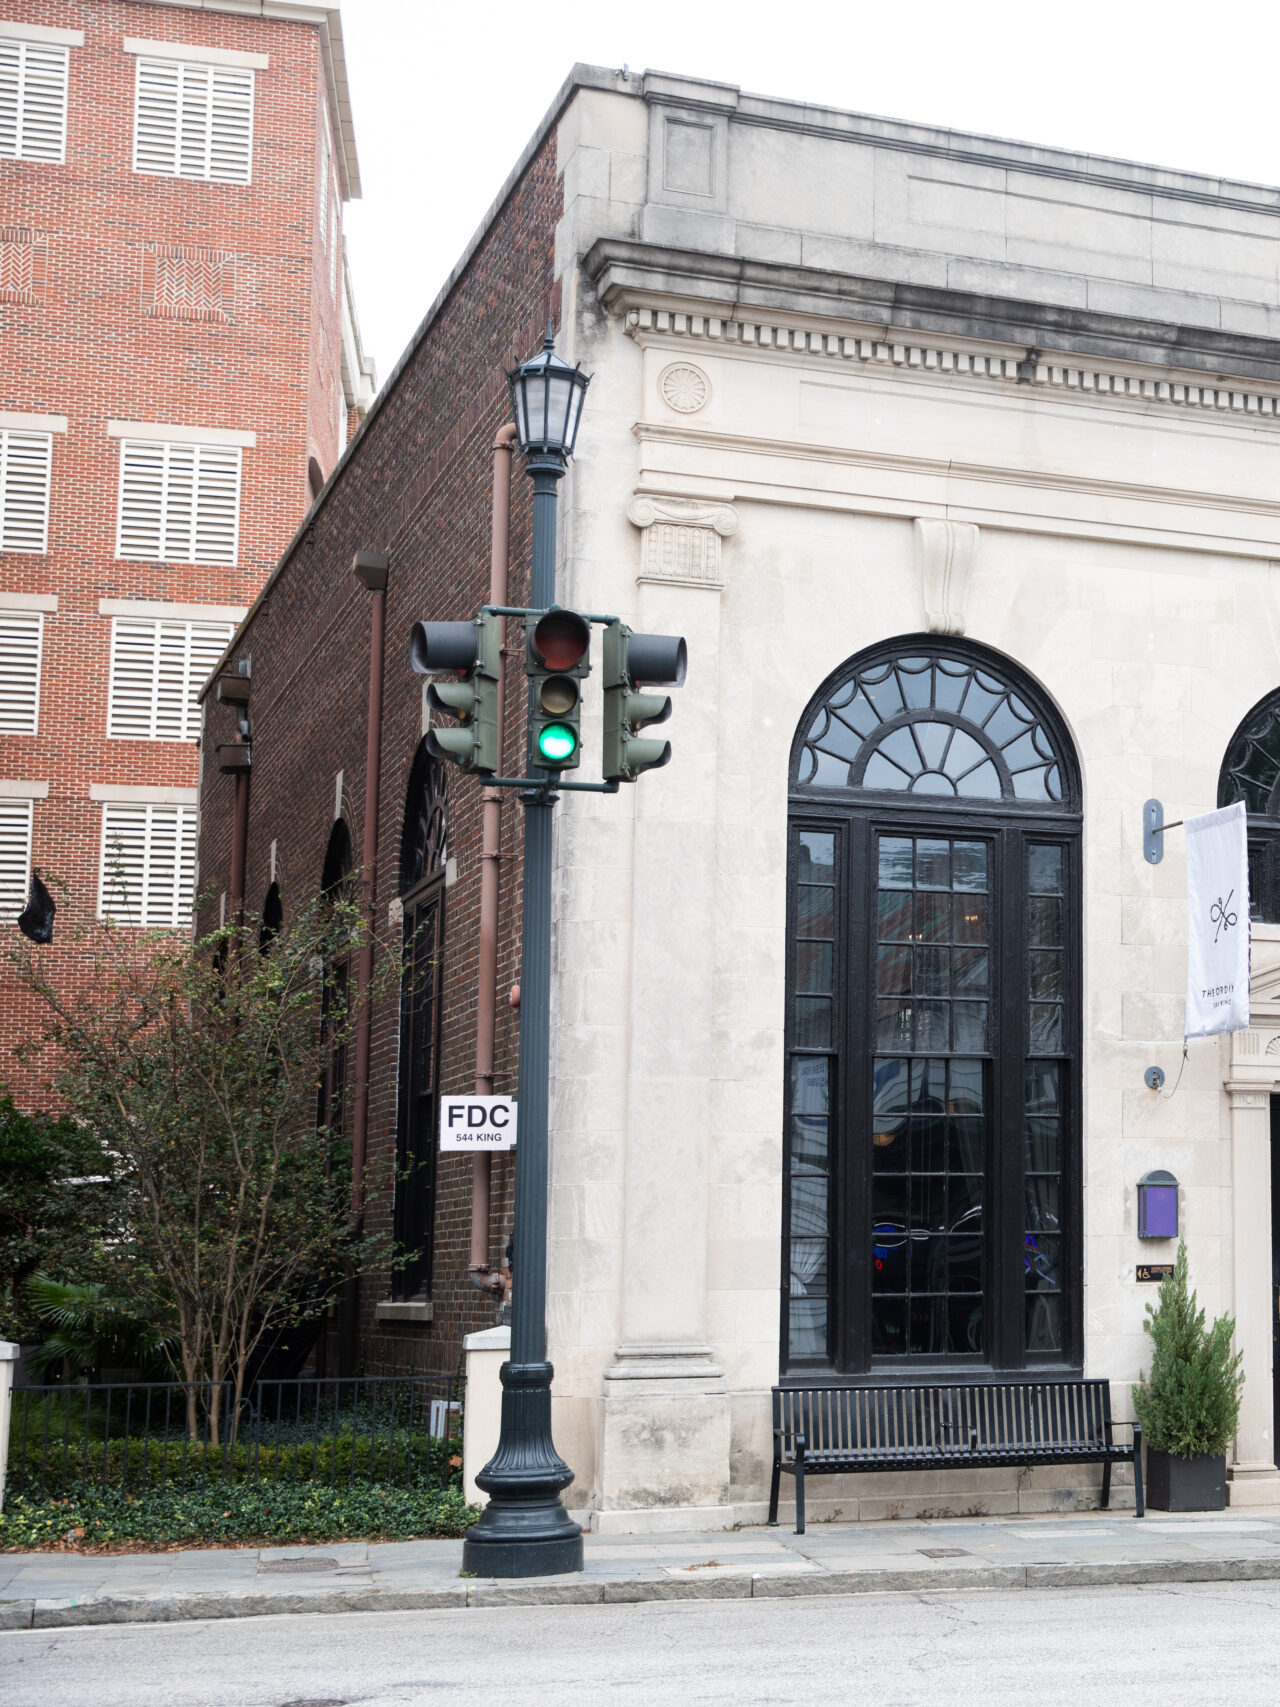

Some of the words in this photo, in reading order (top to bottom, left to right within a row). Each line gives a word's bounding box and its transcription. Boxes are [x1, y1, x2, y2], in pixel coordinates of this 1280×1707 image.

[448, 1104, 509, 1128] FDC
[456, 1133, 473, 1142] 544
[476, 1133, 502, 1142] KING
